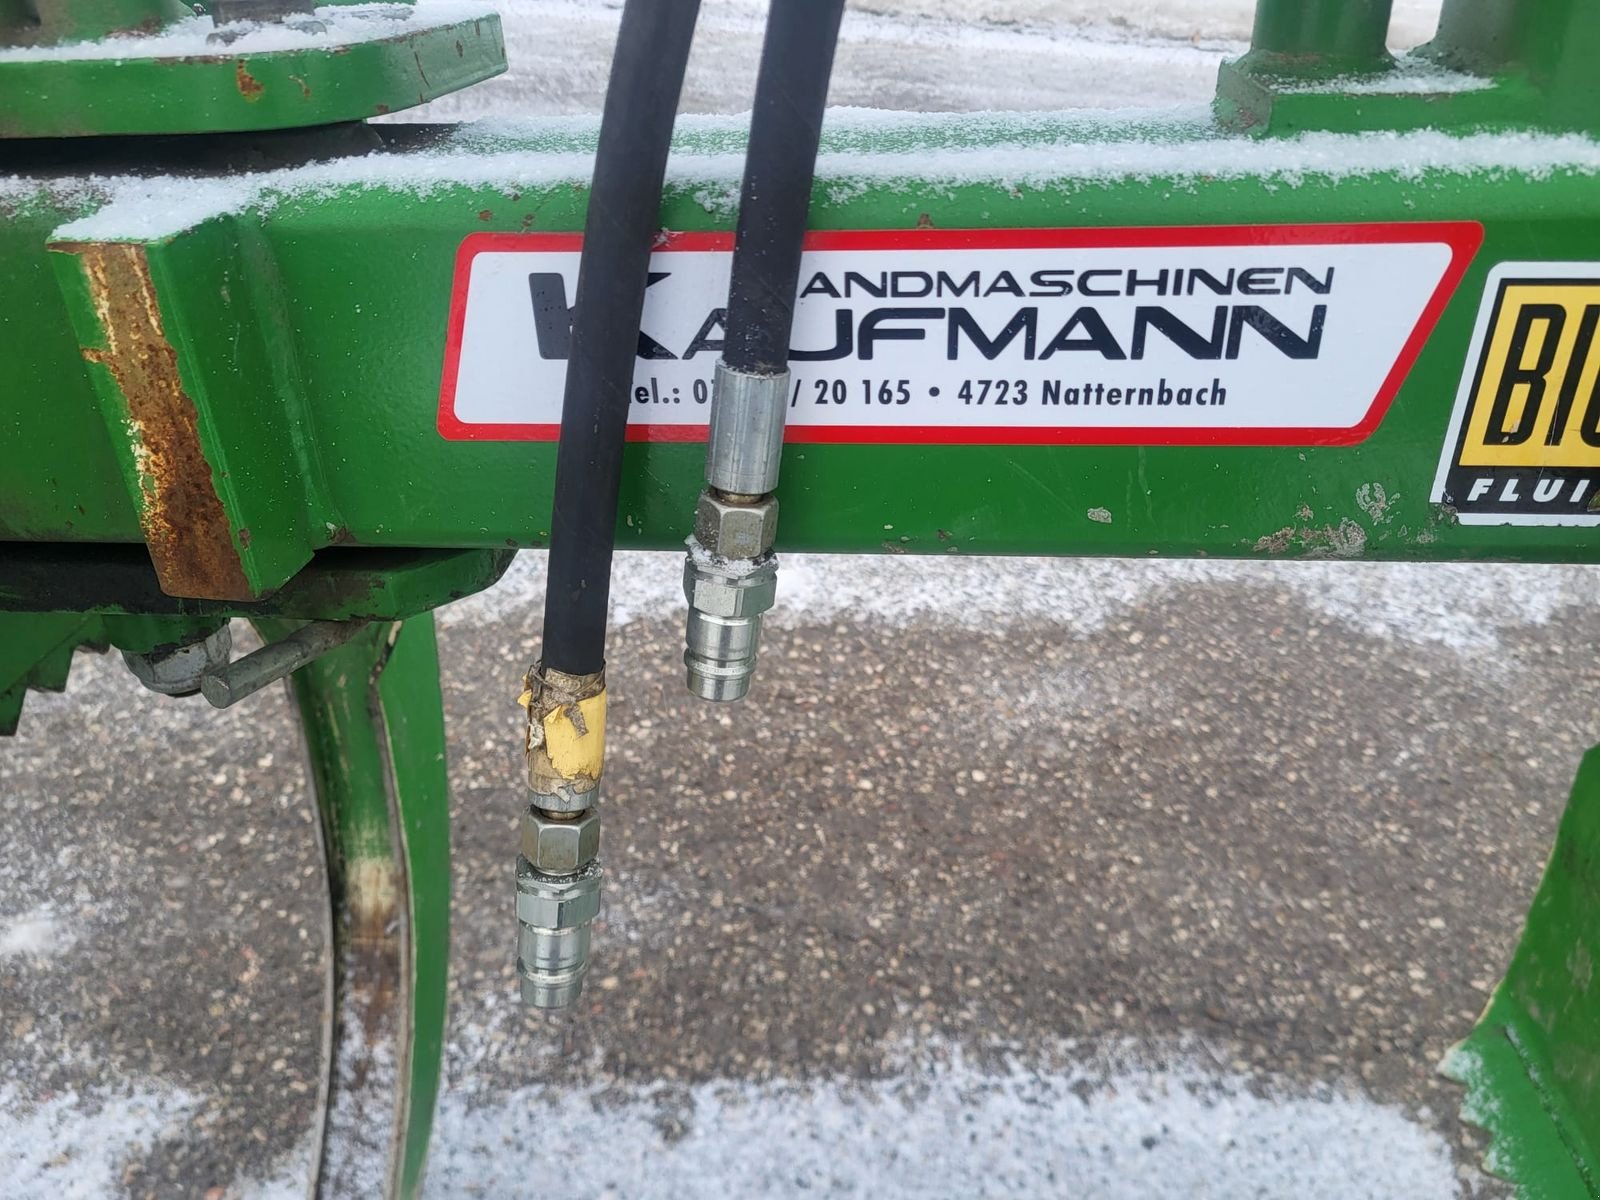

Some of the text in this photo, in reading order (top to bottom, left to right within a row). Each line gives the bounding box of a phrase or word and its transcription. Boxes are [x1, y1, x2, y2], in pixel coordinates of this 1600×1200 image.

[800, 266, 1335, 298] ANDMASCHINEN
[1482, 303, 1600, 448] BI
[630, 377, 681, 404] el.:
[814, 379, 848, 405] 20
[862, 379, 911, 405] 165
[957, 379, 1029, 406] 4723
[1041, 377, 1228, 407] Natternbach
[1466, 478, 1591, 503] FLUI
